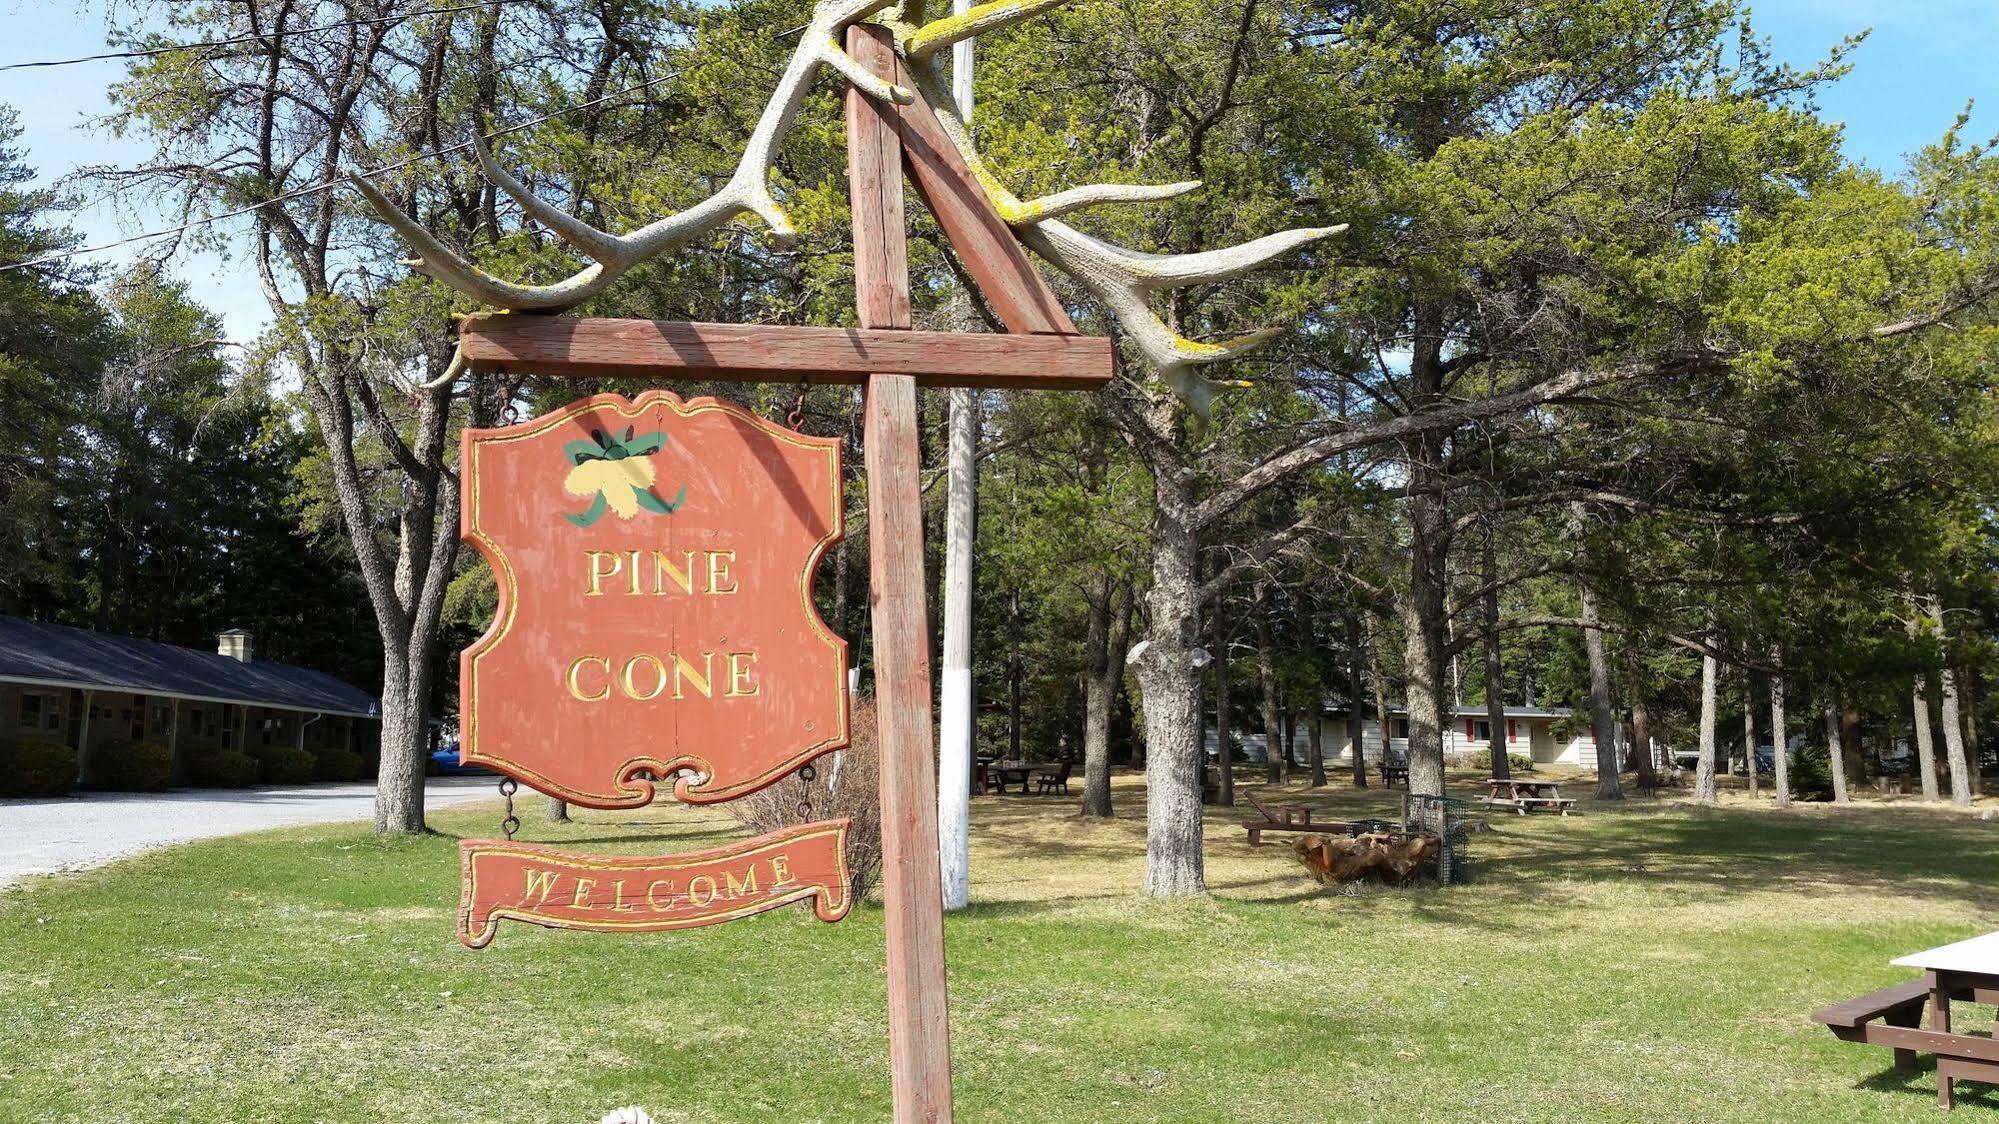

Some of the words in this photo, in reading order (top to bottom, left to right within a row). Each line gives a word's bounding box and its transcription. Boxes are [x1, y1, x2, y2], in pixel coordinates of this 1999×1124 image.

[584, 550, 738, 596] PINE
[566, 652, 760, 701] CONE
[521, 853, 797, 912] WELCOME
